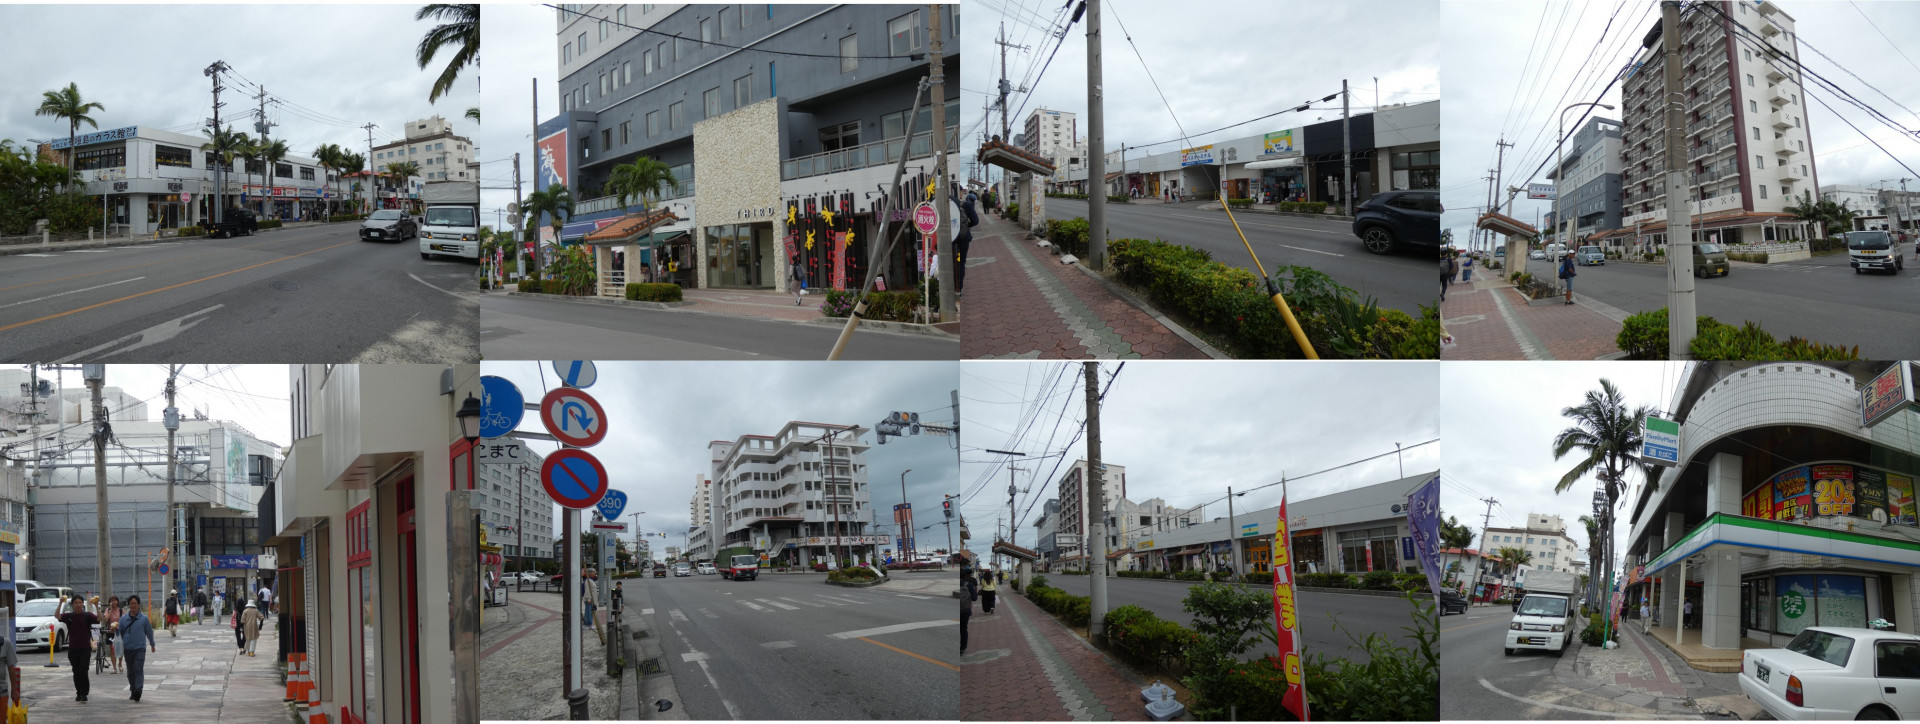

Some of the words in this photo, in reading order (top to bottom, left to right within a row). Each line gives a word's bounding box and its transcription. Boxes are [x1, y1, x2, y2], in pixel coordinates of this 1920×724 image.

[68, 129, 126, 147] 垣島のガラス館
[737, 206, 775, 218] THIRD
[918, 213, 935, 225] 消火栓
[1646, 433, 1677, 444] FamilyMart
[1658, 450, 1673, 459] たばこ
[600, 498, 622, 510] 390
[1818, 503, 1853, 516] OFF
